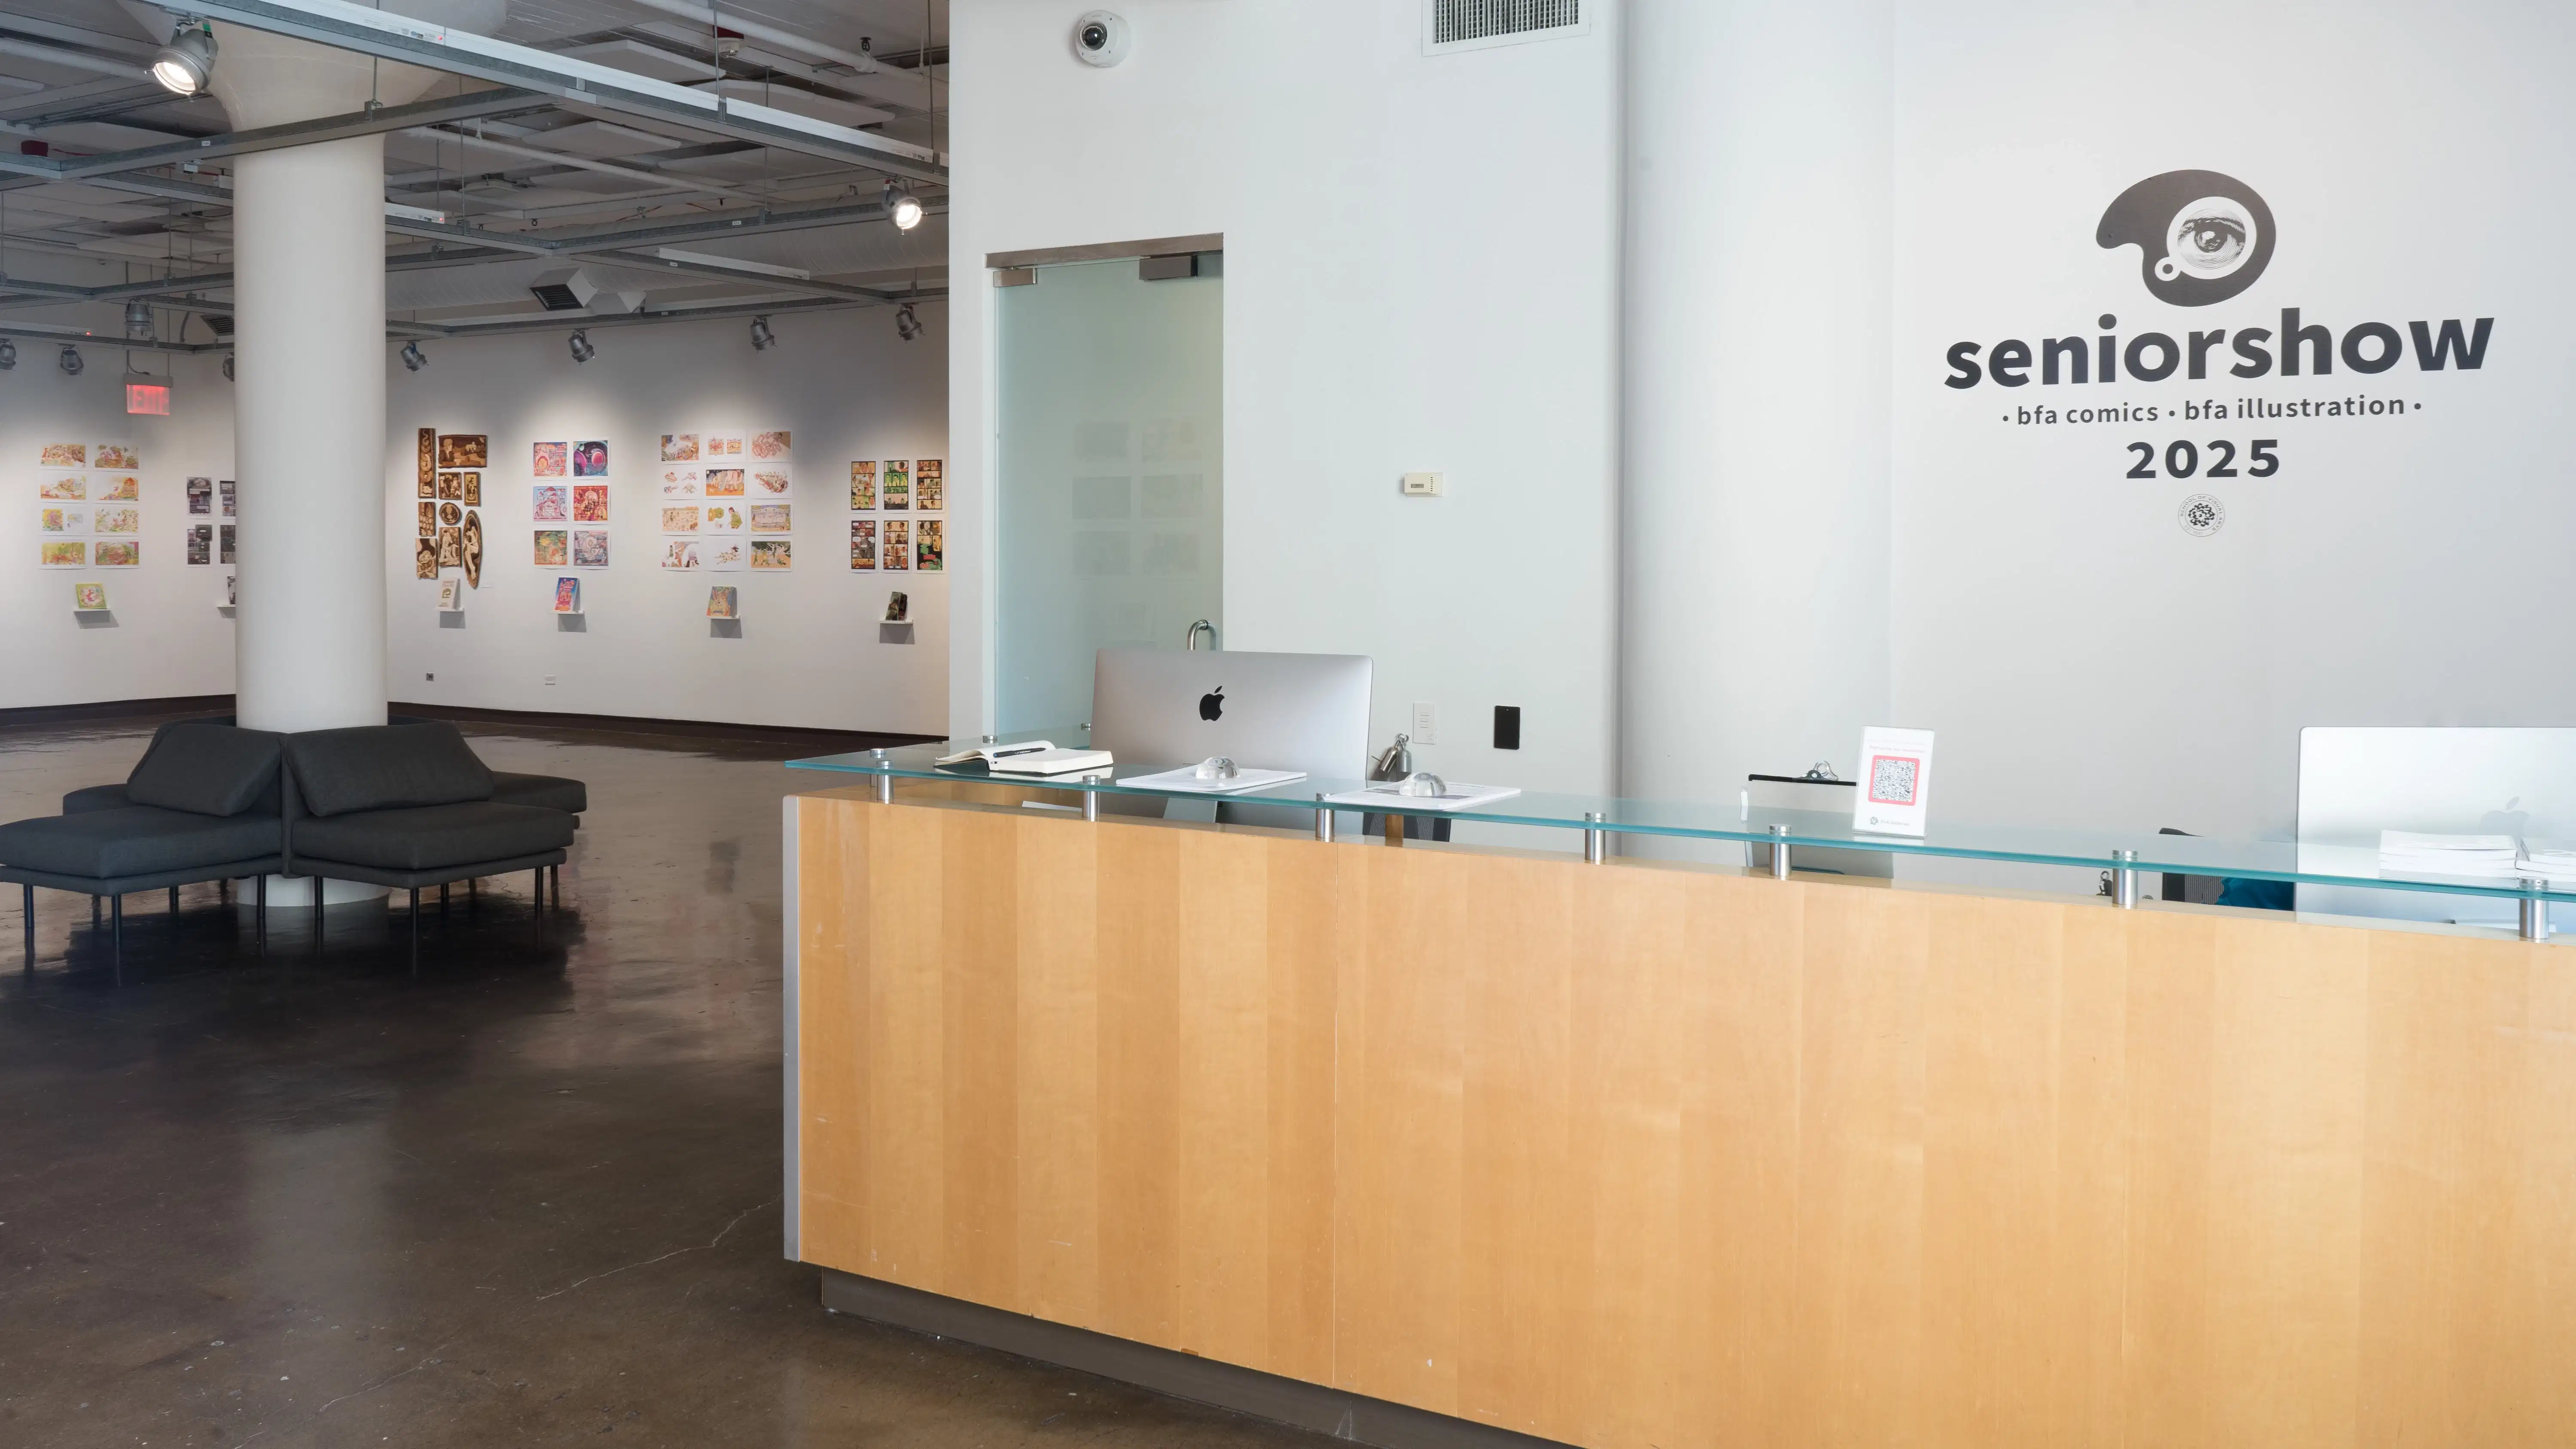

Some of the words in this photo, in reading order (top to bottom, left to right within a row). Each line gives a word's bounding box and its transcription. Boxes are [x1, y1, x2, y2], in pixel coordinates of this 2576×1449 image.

[1944, 307, 2494, 389] seniorshow
[2018, 405, 2057, 425] bfa
[2066, 403, 2158, 424] comics
[2185, 399, 2227, 420] bfa
[2238, 394, 2404, 418] illustration
[2126, 439, 2279, 479] 2025
